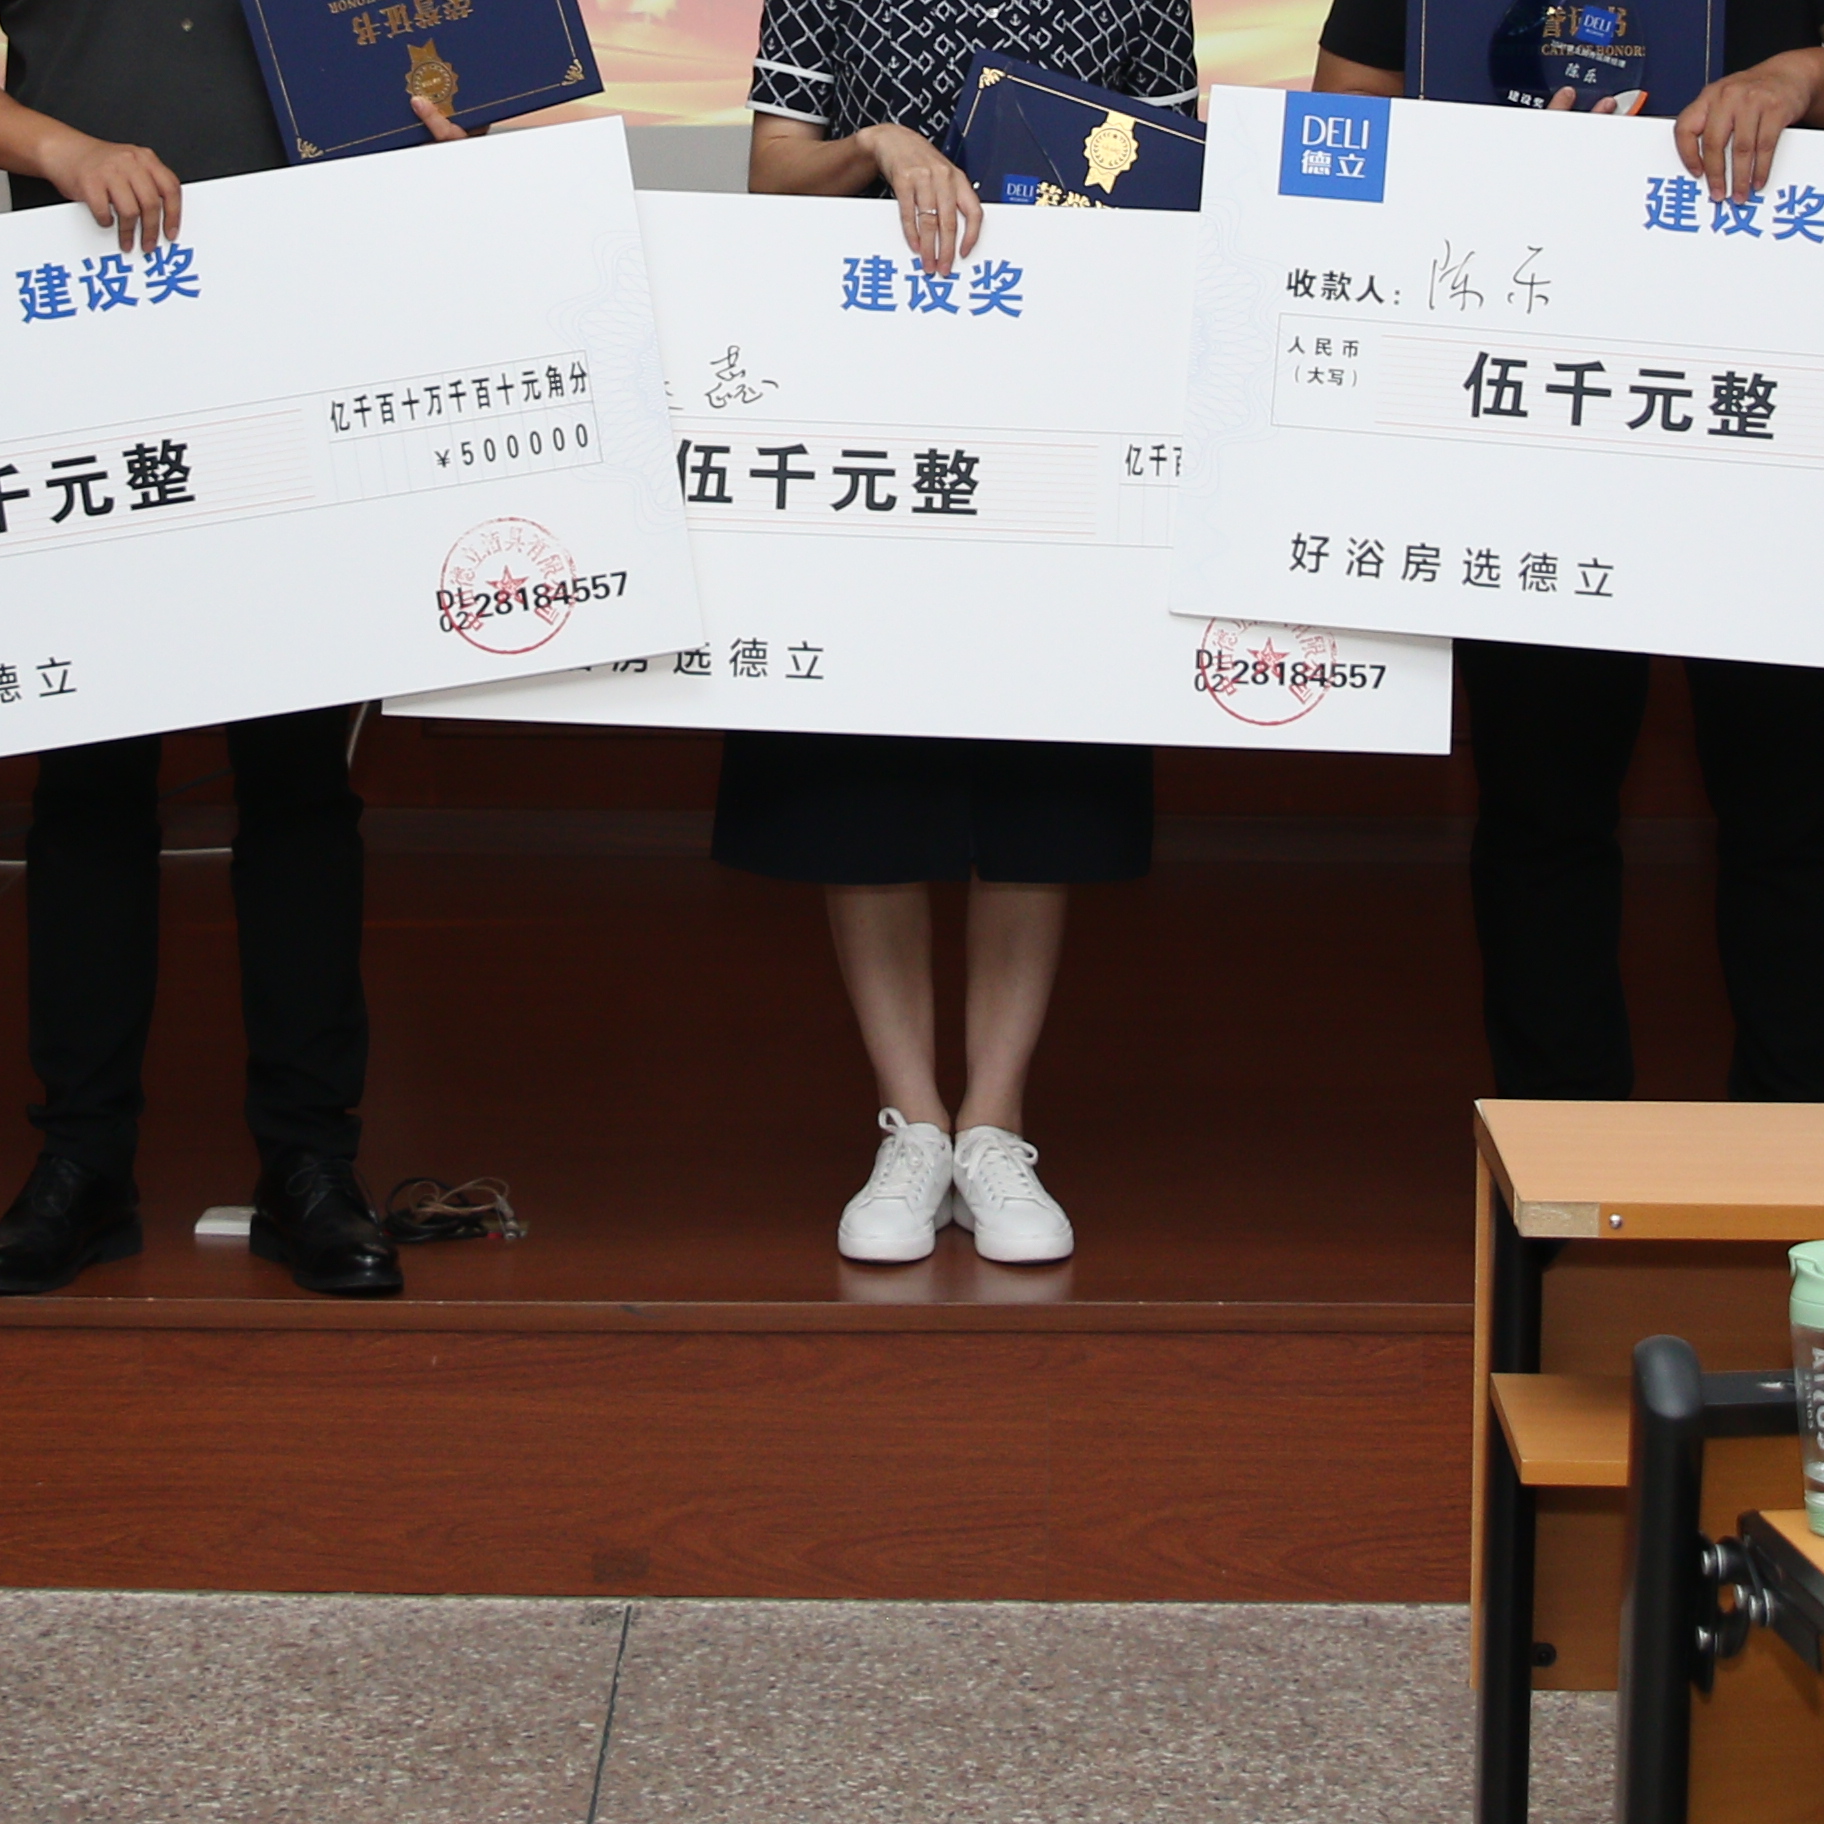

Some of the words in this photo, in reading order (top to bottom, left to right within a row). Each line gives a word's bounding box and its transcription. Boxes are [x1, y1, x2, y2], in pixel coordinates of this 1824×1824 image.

[1583, 14, 1612, 33] DELI
[1302, 114, 1368, 150] DELI
[1301, 147, 1366, 179] 德立
[1006, 182, 1035, 197] DELI
[16, 243, 201, 323] 建设奖
[842, 255, 1024, 317] 建设奖
[1287, 335, 1360, 360] 人民币
[1465, 352, 1779, 441] 伍千元整
[676, 437, 982, 516] 伍千元整
[1291, 533, 1614, 598] 好浴房选德立
[475, 571, 627, 618] 28184557
[1231, 660, 1386, 690] 28184557
